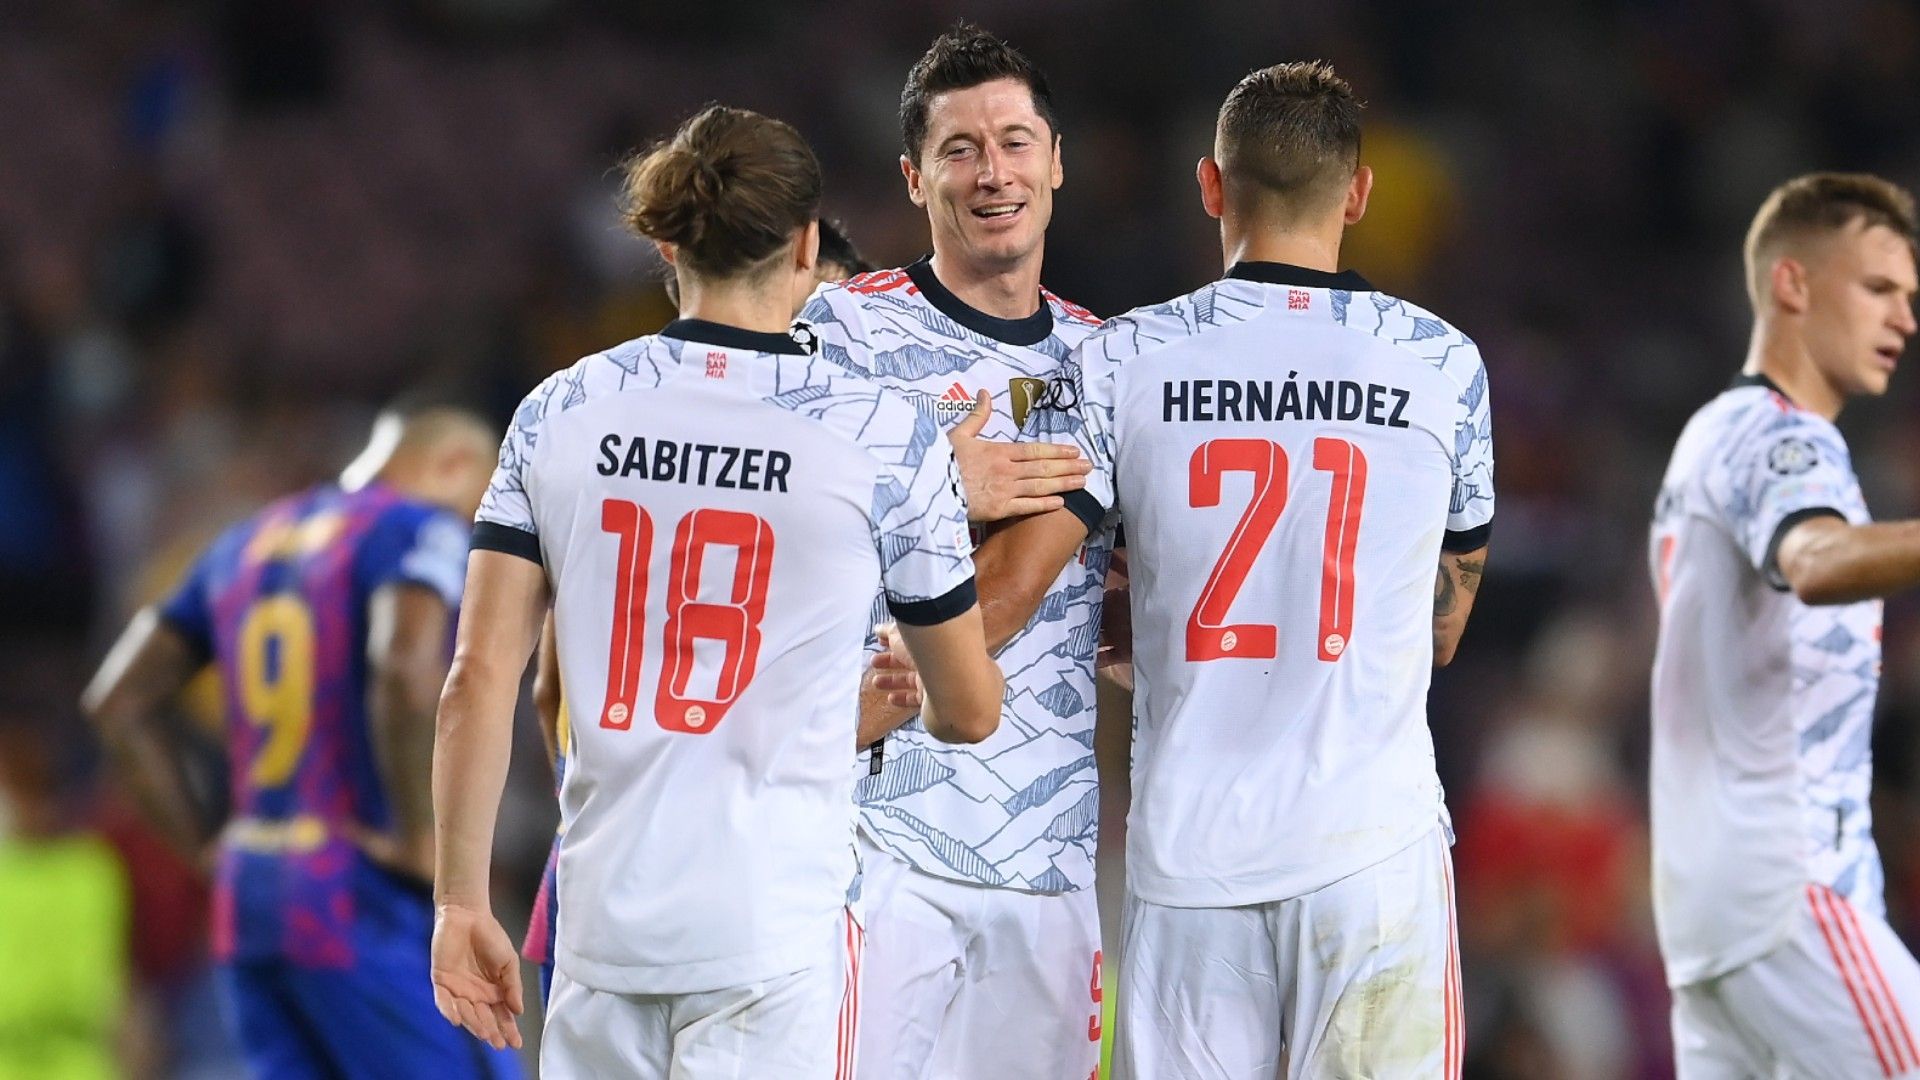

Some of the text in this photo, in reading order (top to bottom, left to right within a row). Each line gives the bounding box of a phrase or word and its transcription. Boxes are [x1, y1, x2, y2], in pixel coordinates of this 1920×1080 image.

[1288, 296, 1310, 304] SAN
[1288, 303, 1309, 311] MIA
[706, 360, 726, 369] SAN
[707, 352, 726, 361] MIA
[705, 369, 725, 379] MIA
[1162, 371, 1411, 429] HERNÁNDEZ
[596, 433, 792, 493] SABITZER
[1185, 437, 1368, 663] 21
[599, 498, 776, 735] 18
[236, 594, 316, 788] 9
